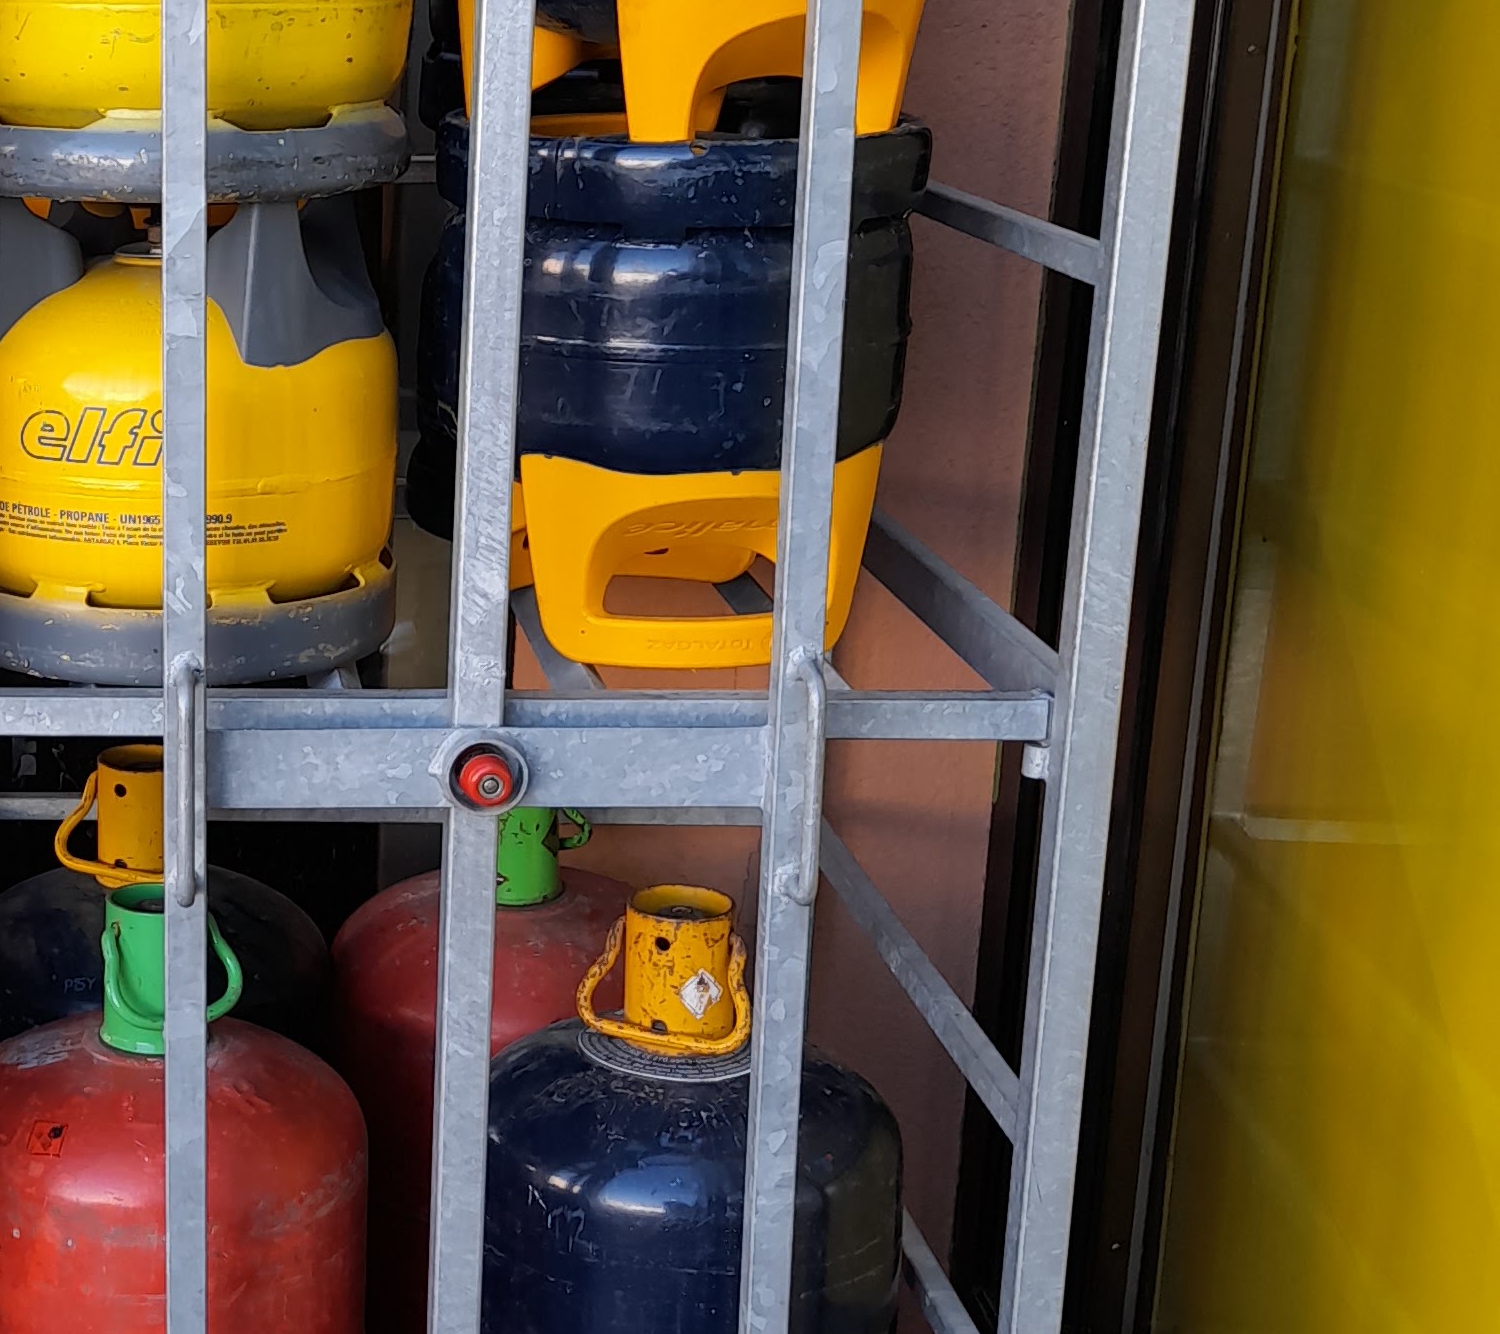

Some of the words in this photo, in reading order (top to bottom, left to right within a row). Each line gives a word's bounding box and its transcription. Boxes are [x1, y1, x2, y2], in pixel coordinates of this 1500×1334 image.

[20, 406, 164, 467] elfi
[0, 500, 10, 513] DE
[60, 509, 110, 524] PROPANE
